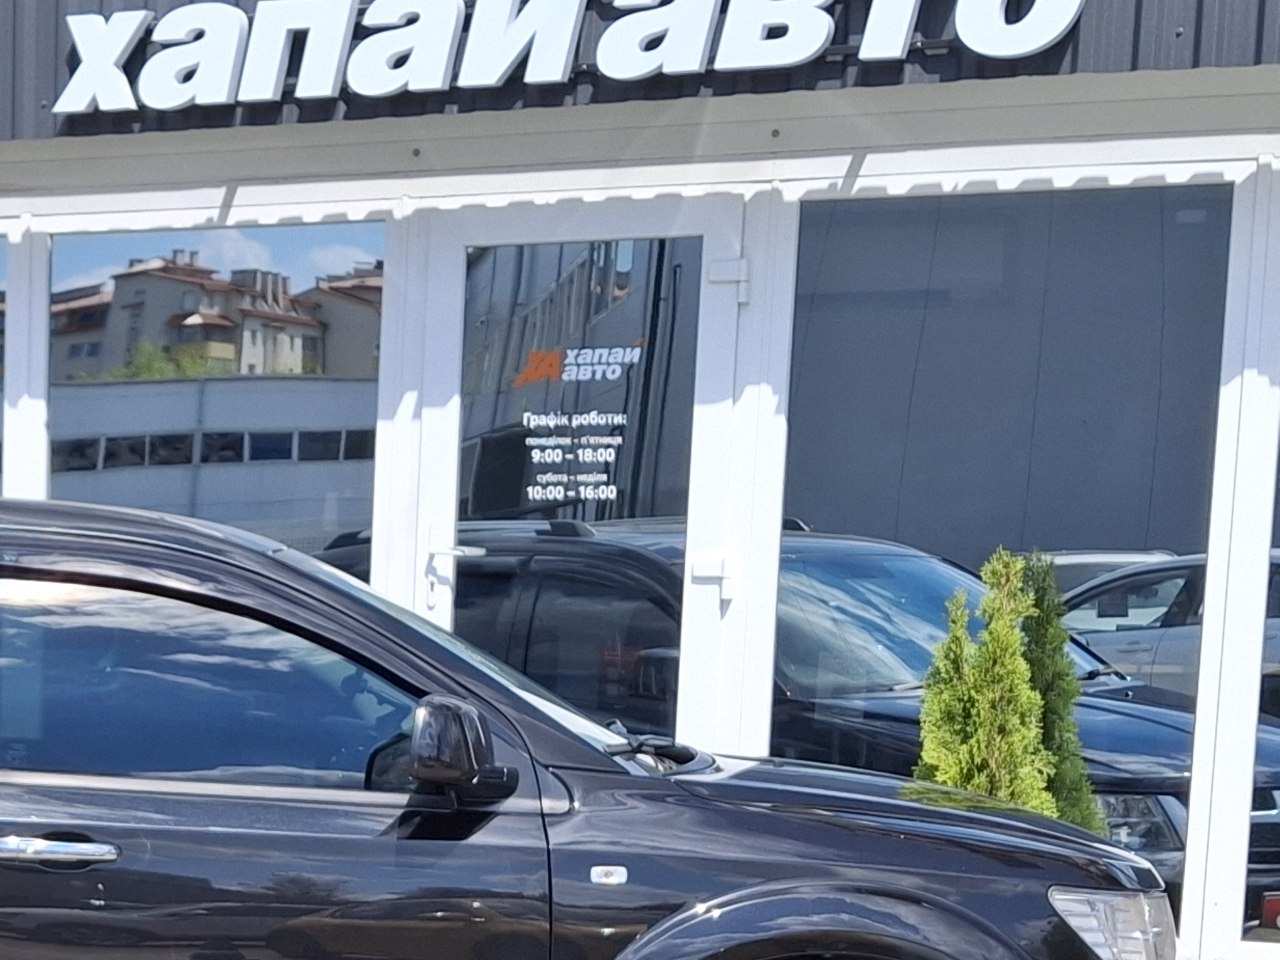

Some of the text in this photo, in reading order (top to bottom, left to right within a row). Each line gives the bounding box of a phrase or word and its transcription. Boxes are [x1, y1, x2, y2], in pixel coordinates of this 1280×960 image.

[561, 364, 622, 381] авто
[523, 410, 627, 429] Графік роботи:
[531, 448, 563, 463] 9:00
[576, 448, 615, 463] 18:00
[526, 485, 565, 500] 10:00
[578, 485, 617, 500] 16:00
